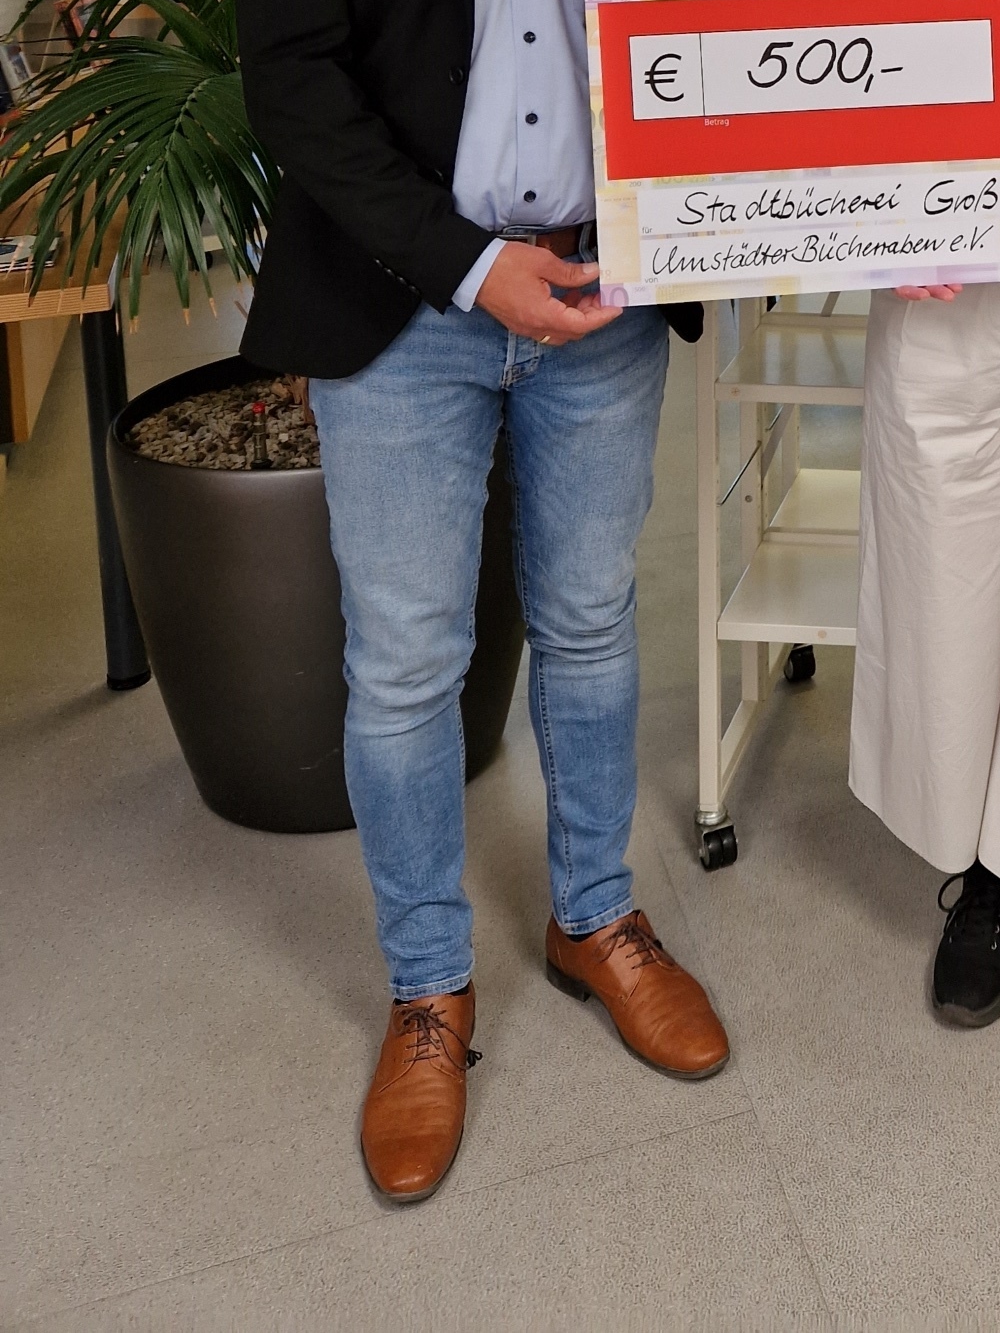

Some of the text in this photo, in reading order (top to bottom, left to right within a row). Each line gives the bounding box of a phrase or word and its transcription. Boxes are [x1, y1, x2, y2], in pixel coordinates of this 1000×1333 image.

[704, 117, 730, 127] Betrag
[641, 226, 653, 235] für
[950, 224, 994, 253] e.V.
